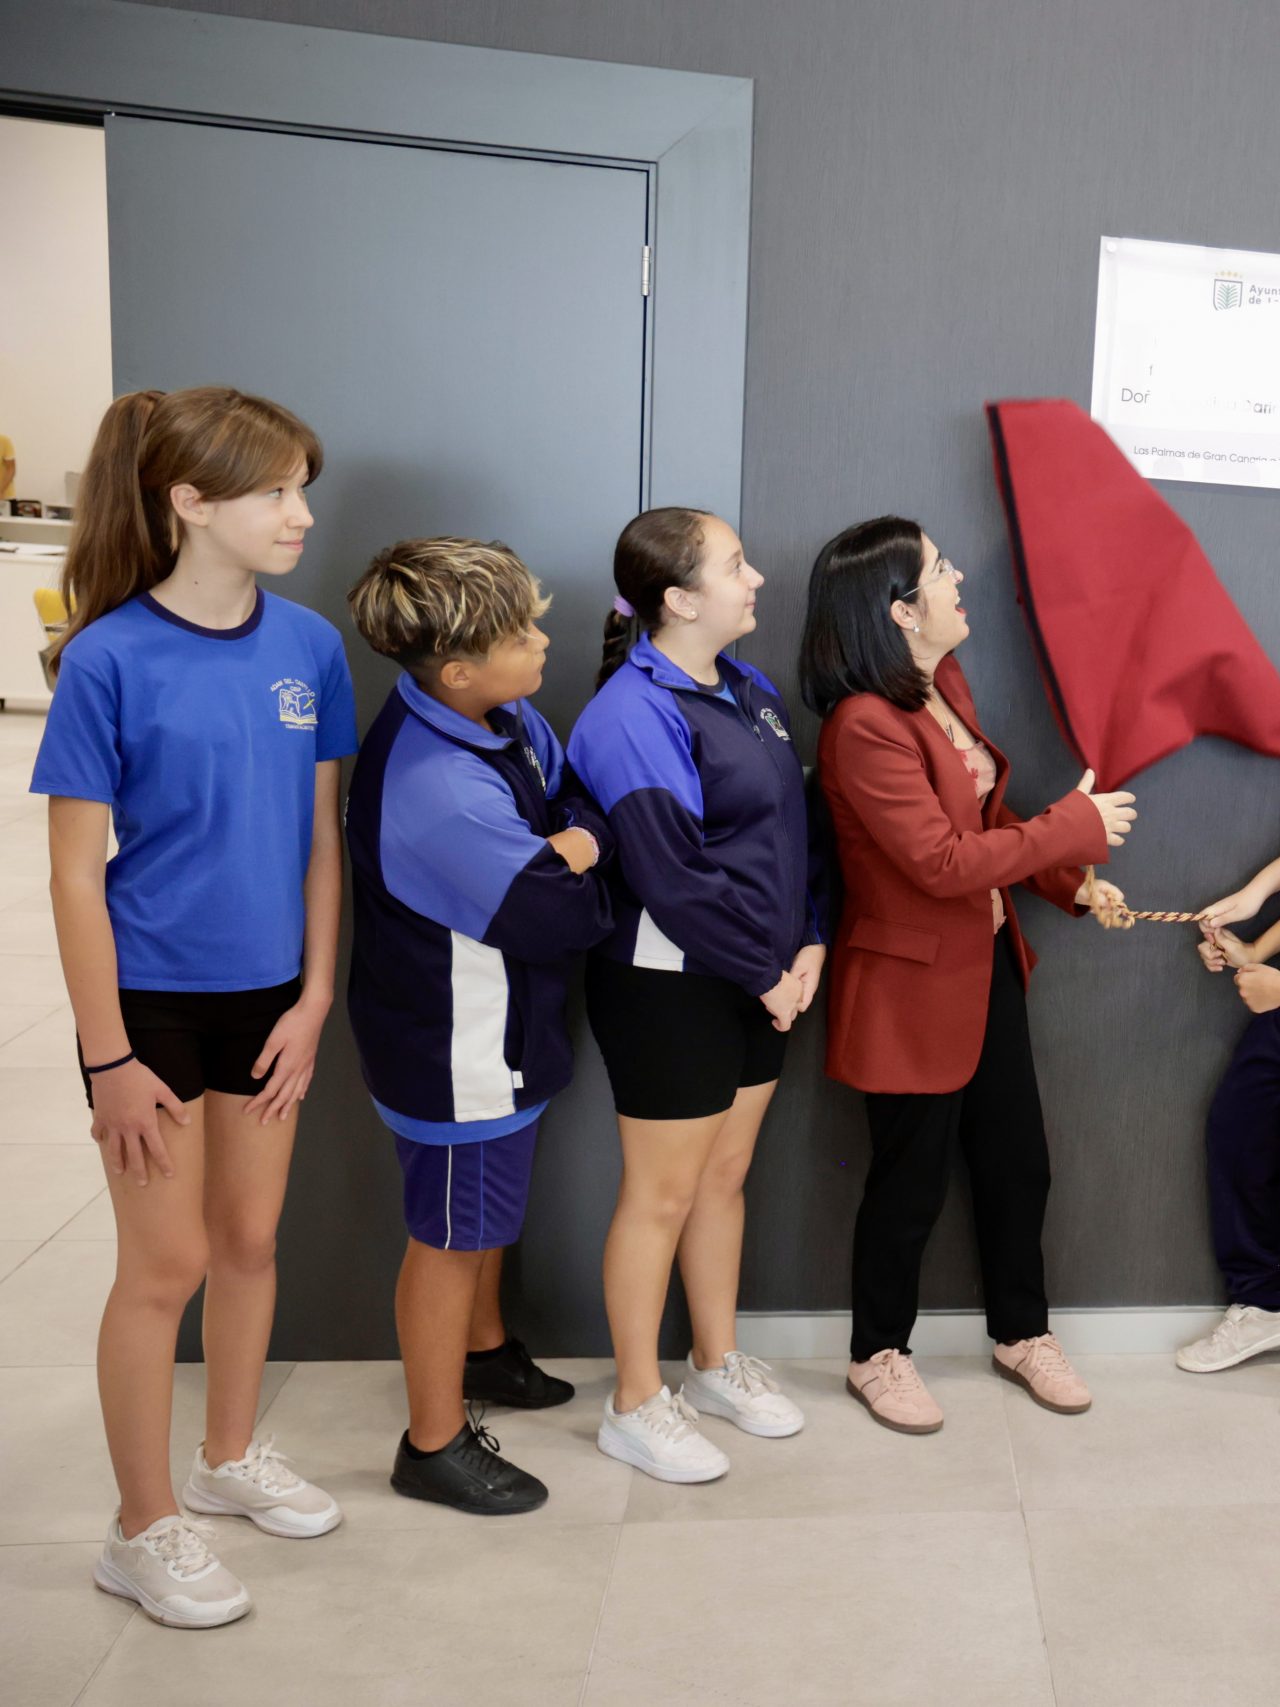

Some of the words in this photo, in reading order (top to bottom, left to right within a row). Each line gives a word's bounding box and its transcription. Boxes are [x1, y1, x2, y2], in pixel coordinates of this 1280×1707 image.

[1248, 295, 1263, 305] de
[1133, 446, 1150, 456] Las
[1151, 446, 1185, 458] Palmas
[1187, 449, 1201, 459] de
[1203, 451, 1227, 462] Gran
